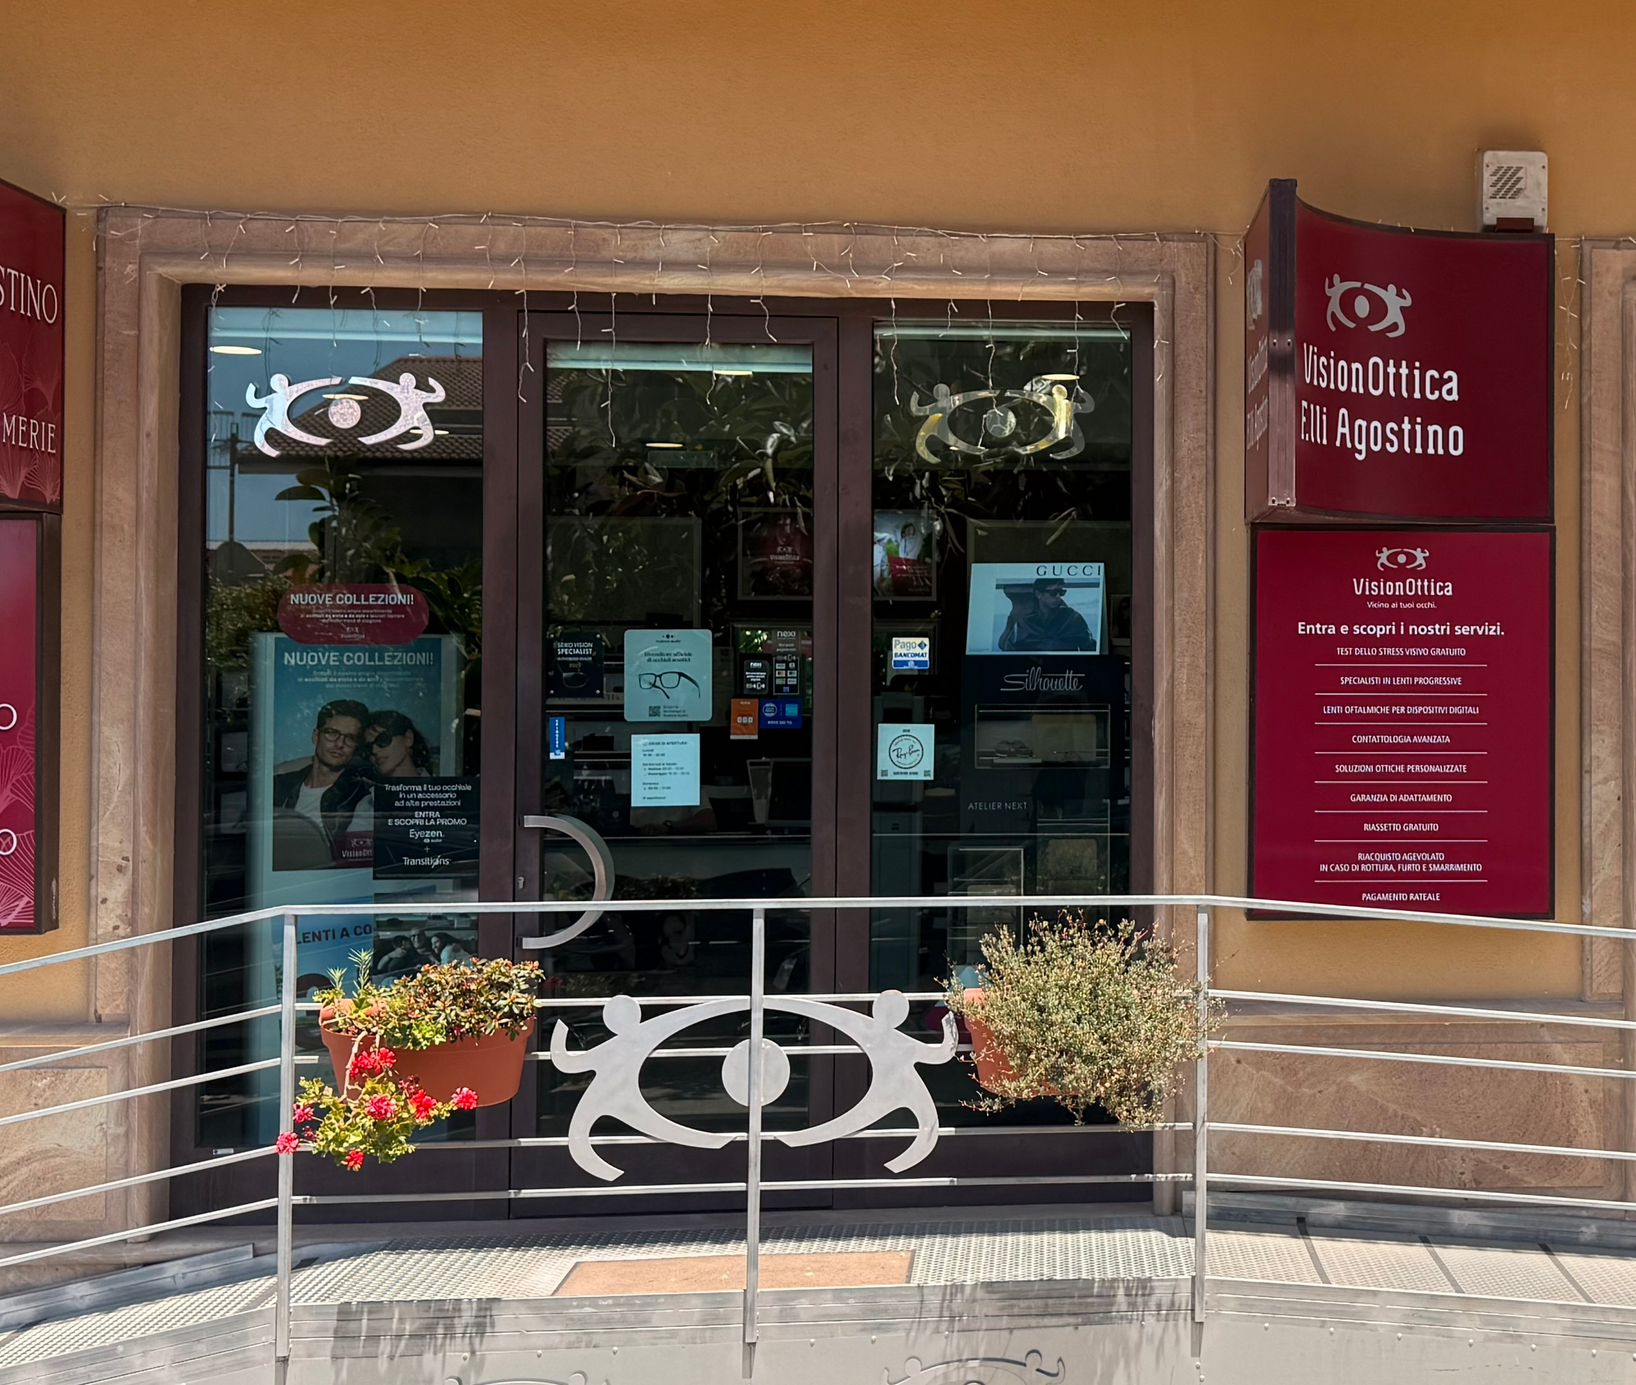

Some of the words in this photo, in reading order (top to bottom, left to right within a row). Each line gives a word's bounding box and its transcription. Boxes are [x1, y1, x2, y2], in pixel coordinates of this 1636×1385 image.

[1304, 342, 1459, 401] VisionOttica
[1301, 400, 1328, 445] F.lli
[1336, 408, 1464, 460] Agostino
[1036, 564, 1101, 576] GUCCI
[1353, 578, 1453, 596] VisionOttica
[290, 593, 334, 606] NUOVE
[336, 593, 414, 606] COLLEZIONI!
[1298, 622, 1336, 636] Entra
[1340, 626, 1349, 636] e
[1353, 622, 1396, 638] scopri
[1400, 622, 1404, 636] i
[1409, 622, 1450, 636] nostri
[1454, 622, 1504, 636] servizi.
[894, 640, 916, 651] Pago
[284, 652, 339, 666] NUOVE
[343, 652, 434, 666] COLLEZIONI!
[1000, 666, 1086, 691] Silhouette
[1340, 676, 1380, 685] SPECIALISTI
[1383, 676, 1390, 685] IN
[1392, 676, 1412, 685] LENTI
[1414, 676, 1462, 685] PROGRESSIVE
[1323, 706, 1342, 714] LENTI
[1345, 706, 1390, 714] OFTALMICHE
[1392, 706, 1405, 714] PER
[1407, 706, 1448, 714] DISPOSITIVI
[1450, 706, 1479, 714] DIGITALI
[1335, 764, 1374, 773] SOLUZIONI
[1376, 764, 1404, 773] OTTICHE
[1407, 764, 1466, 773] PERSONALIZZATE
[1350, 794, 1388, 802] GARANZIA
[1390, 794, 1398, 802] DI
[1399, 794, 1452, 802] ADATTAMENTO
[968, 802, 1002, 810] ATELIER
[1004, 802, 1027, 810] NEXT
[1364, 823, 1401, 831] RIASSETTO
[1403, 823, 1439, 831] GRATUITO
[402, 855, 450, 868] Transitions
[1358, 852, 1401, 862] RIACQUISTO
[1402, 852, 1445, 860] AGEVOLATO
[1320, 864, 1328, 872] IN
[1330, 864, 1350, 872] CASO
[1352, 864, 1360, 872] DI
[1361, 864, 1396, 873] ROTTURA,
[1398, 864, 1420, 872] FURTO
[1422, 864, 1427, 872] E
[1428, 864, 1482, 872] SMARRIMENTO
[1362, 892, 1408, 901] PAGAMENTO
[1410, 892, 1440, 901] RATEALE
[340, 927, 350, 938] A
